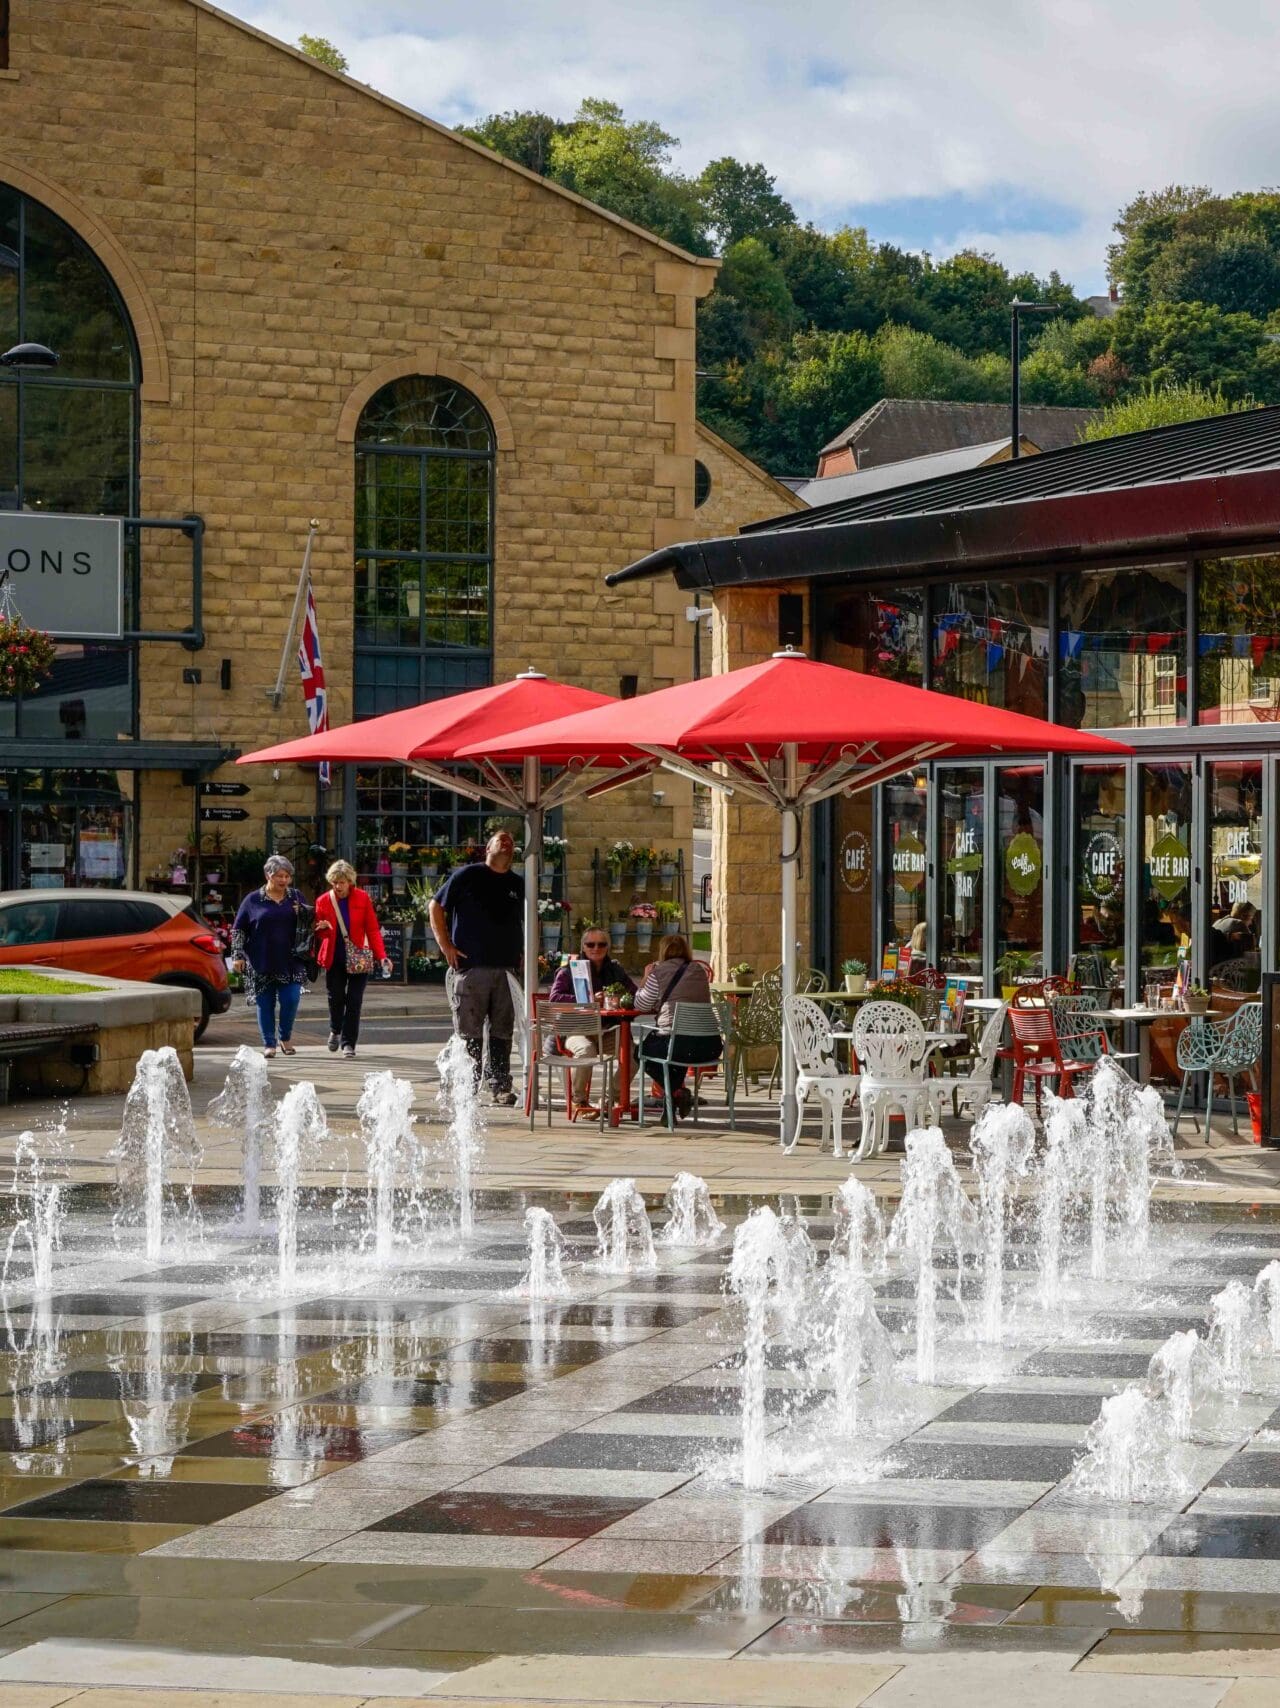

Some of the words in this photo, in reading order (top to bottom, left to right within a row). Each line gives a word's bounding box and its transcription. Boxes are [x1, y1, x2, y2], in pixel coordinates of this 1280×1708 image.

[955, 828, 975, 853] CAFÉ
[1226, 827, 1250, 856] CAFÉ
[845, 844, 865, 870] CAFÉ
[892, 849, 910, 872] CAFÉ
[911, 853, 925, 872] BAR
[1092, 846, 1116, 875] CAFÉ
[1149, 852, 1171, 877] CAFÉ
[1172, 856, 1190, 878] BAR
[957, 876, 973, 898] BAR
[1228, 881, 1248, 904] BAR
